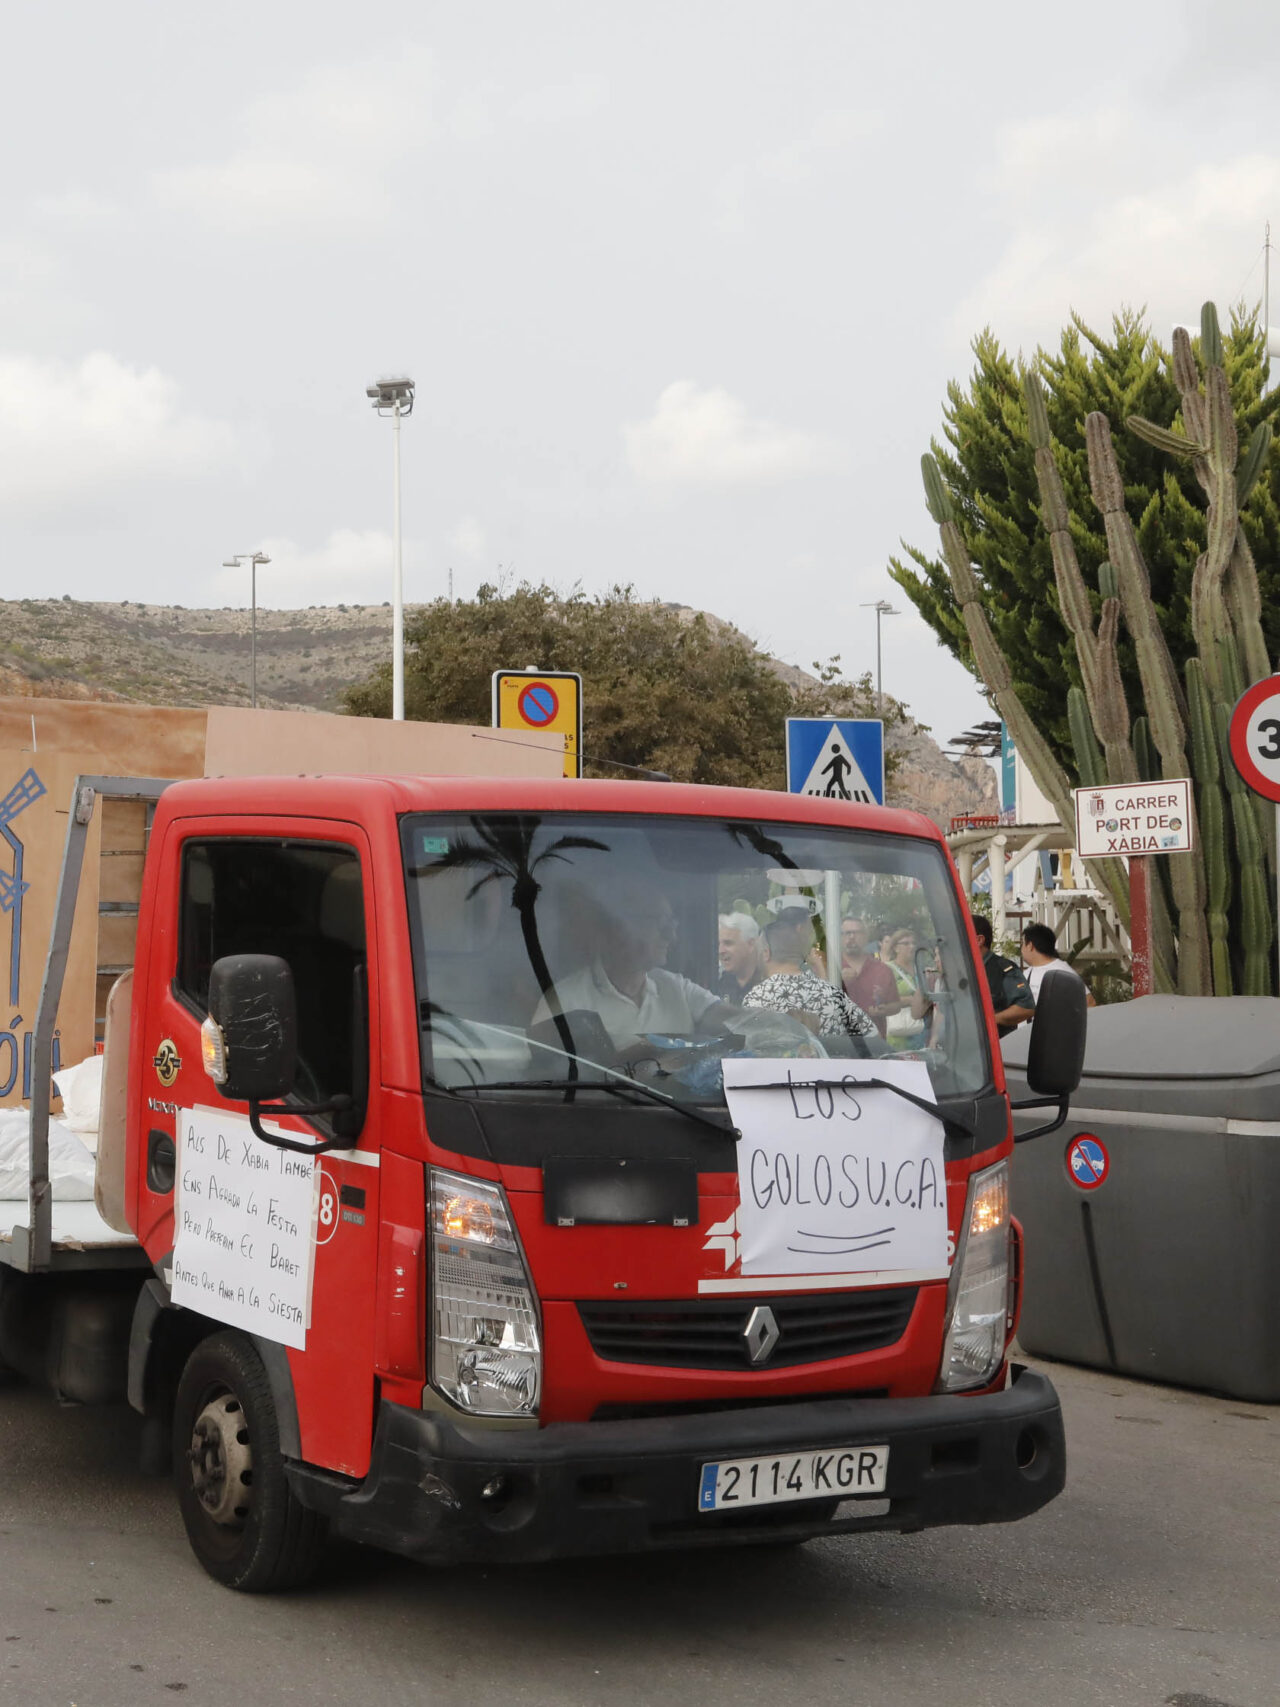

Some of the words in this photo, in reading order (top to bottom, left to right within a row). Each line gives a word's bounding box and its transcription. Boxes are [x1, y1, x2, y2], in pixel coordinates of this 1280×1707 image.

[1115, 795, 1178, 811] CARRER
[1096, 817, 1142, 833] PRT
[1147, 815, 1169, 829] DE
[1107, 834, 1159, 851] XÀBIA
[787, 1068, 862, 1121] LOS
[270, 1242, 301, 1278] BARET
[721, 1458, 804, 1502] 2114
[814, 1452, 879, 1491] KGR
